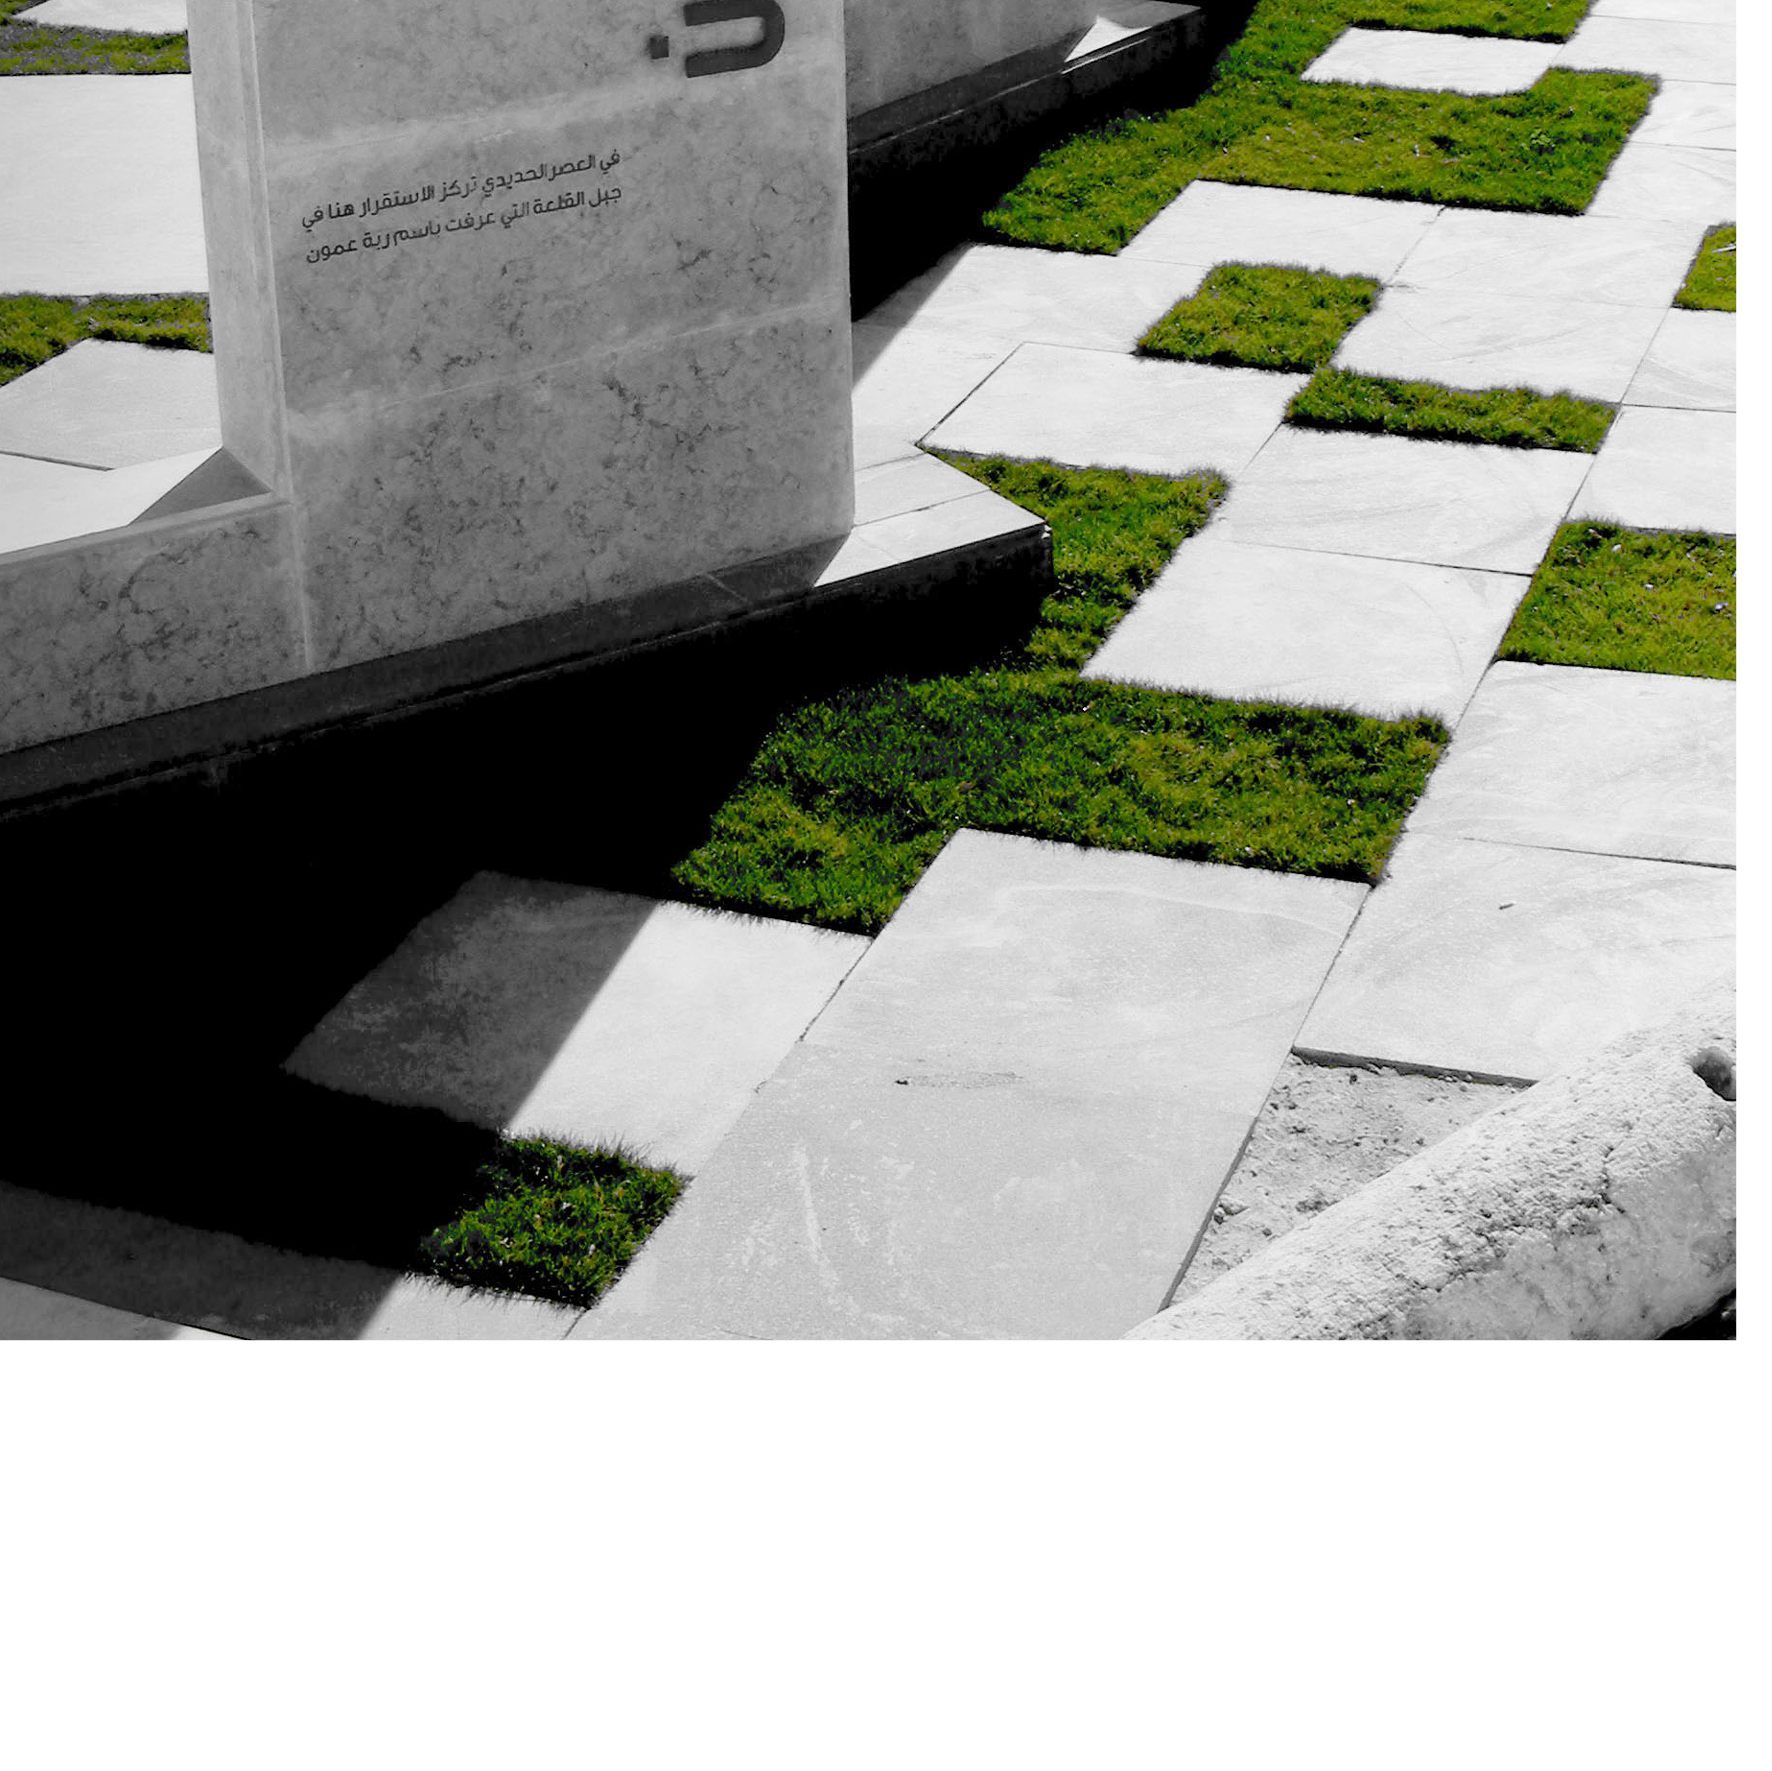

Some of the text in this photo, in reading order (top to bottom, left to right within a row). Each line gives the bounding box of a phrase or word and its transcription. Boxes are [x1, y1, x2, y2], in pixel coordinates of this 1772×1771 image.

[302, 149, 621, 233] في العصر الحديدي تركز الاستقرار هنا في
[305, 187, 622, 264] جبل القلعة التي عرفت باسم ربة عمون
